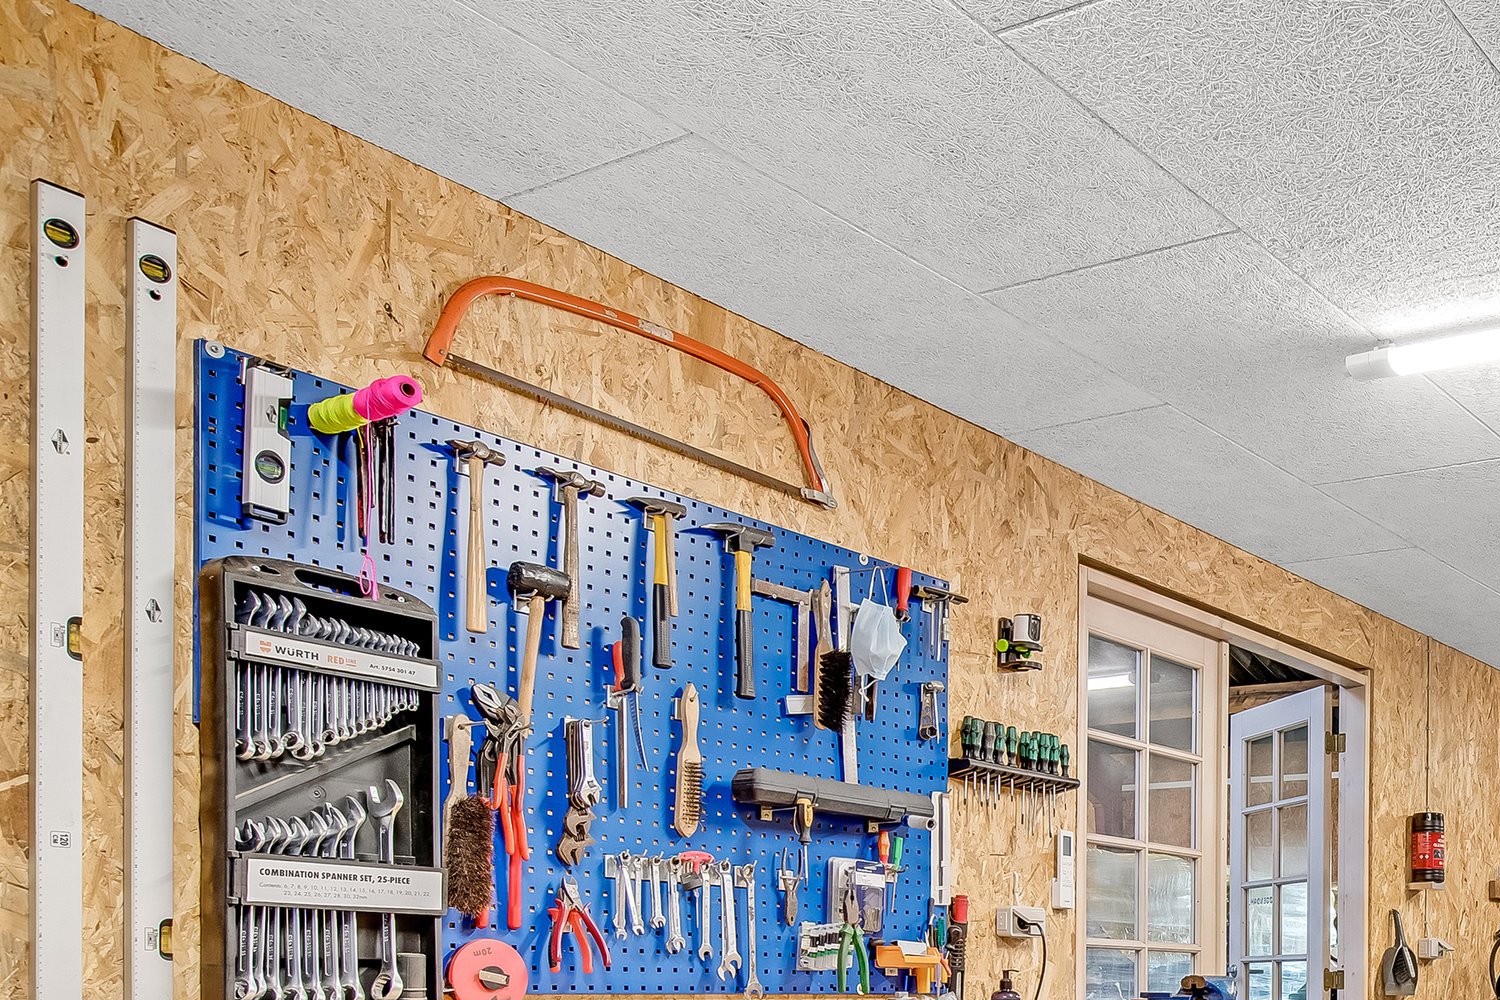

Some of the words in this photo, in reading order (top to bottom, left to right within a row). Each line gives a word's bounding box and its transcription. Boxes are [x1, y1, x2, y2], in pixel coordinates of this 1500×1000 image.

[275, 645, 319, 661] WÜRTH
[327, 655, 345, 665] RED
[259, 868, 320, 879] COMBINATION
[321, 872, 358, 881] SPANNER
[360, 874, 375, 884] SET,
[377, 875, 410, 885] 25-PIECE
[473, 947, 492, 957] 20m
